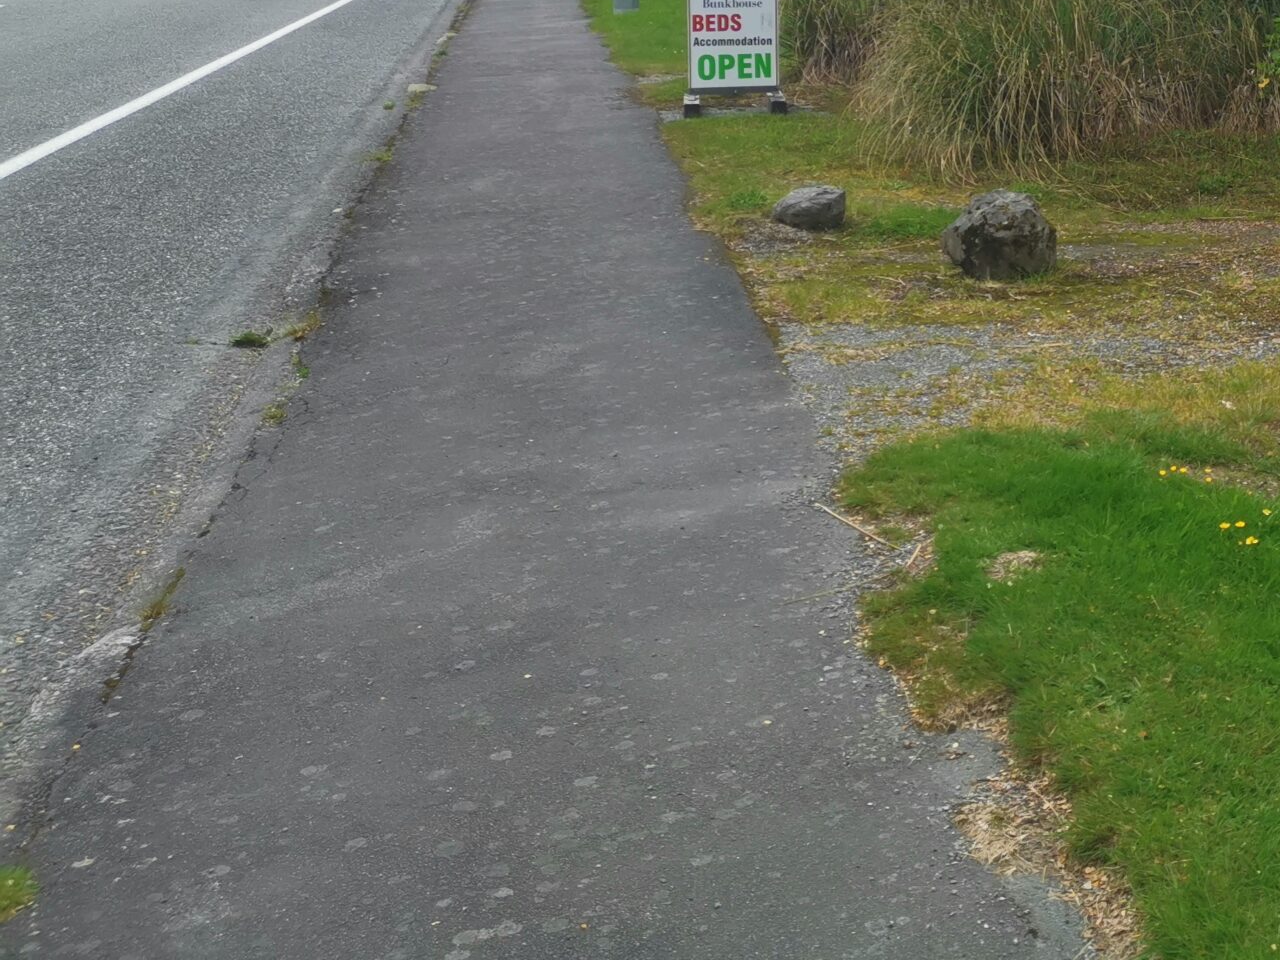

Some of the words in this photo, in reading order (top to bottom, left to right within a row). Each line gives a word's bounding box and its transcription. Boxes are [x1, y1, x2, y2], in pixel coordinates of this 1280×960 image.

[692, 13, 742, 33] BEDS
[693, 35, 773, 47] Accommodation
[697, 52, 772, 81] OPEN
